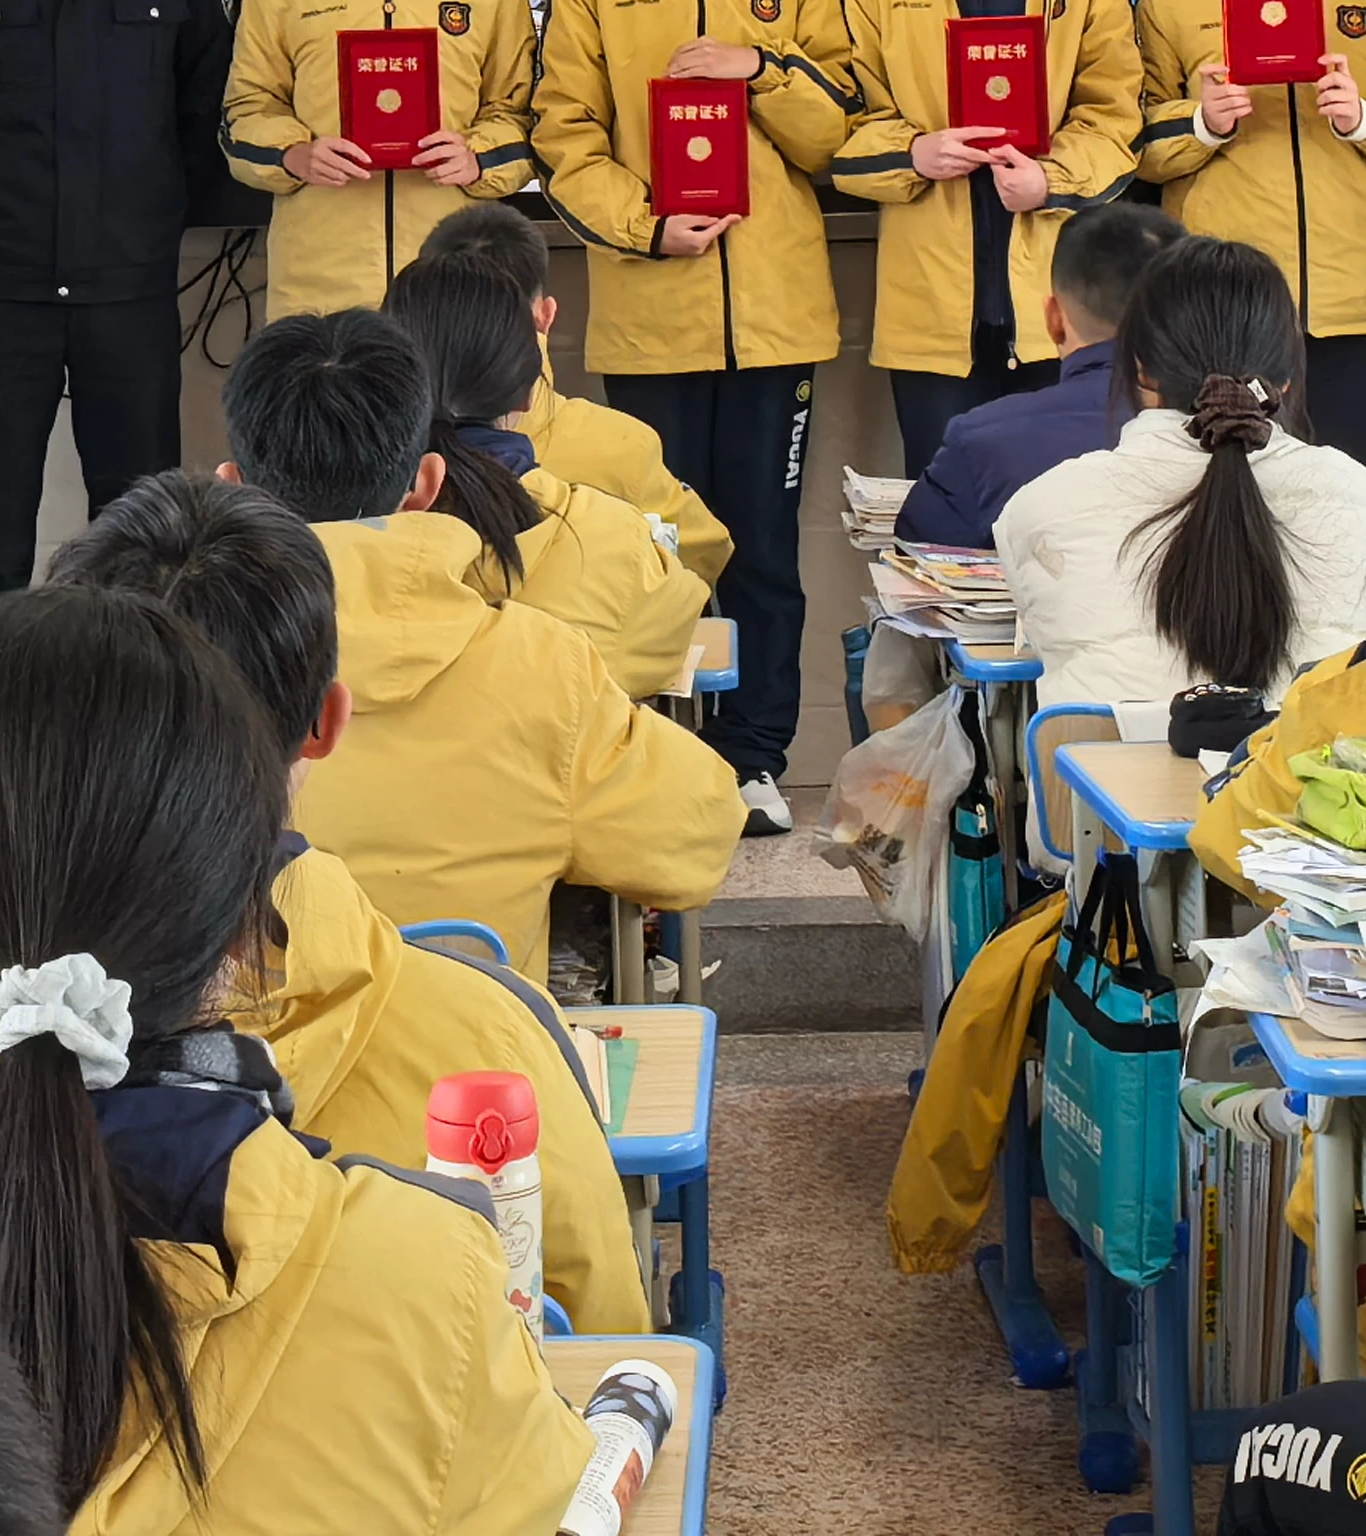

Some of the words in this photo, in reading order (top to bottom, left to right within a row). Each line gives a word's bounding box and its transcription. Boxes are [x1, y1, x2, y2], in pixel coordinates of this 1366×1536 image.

[967, 42, 1028, 62] 荣誉证书
[357, 55, 419, 74] 荣誉证书
[669, 104, 729, 122] 荣誉证书
[784, 408, 809, 490] YUCAI
[1233, 1422, 1344, 1493] YUCAI
